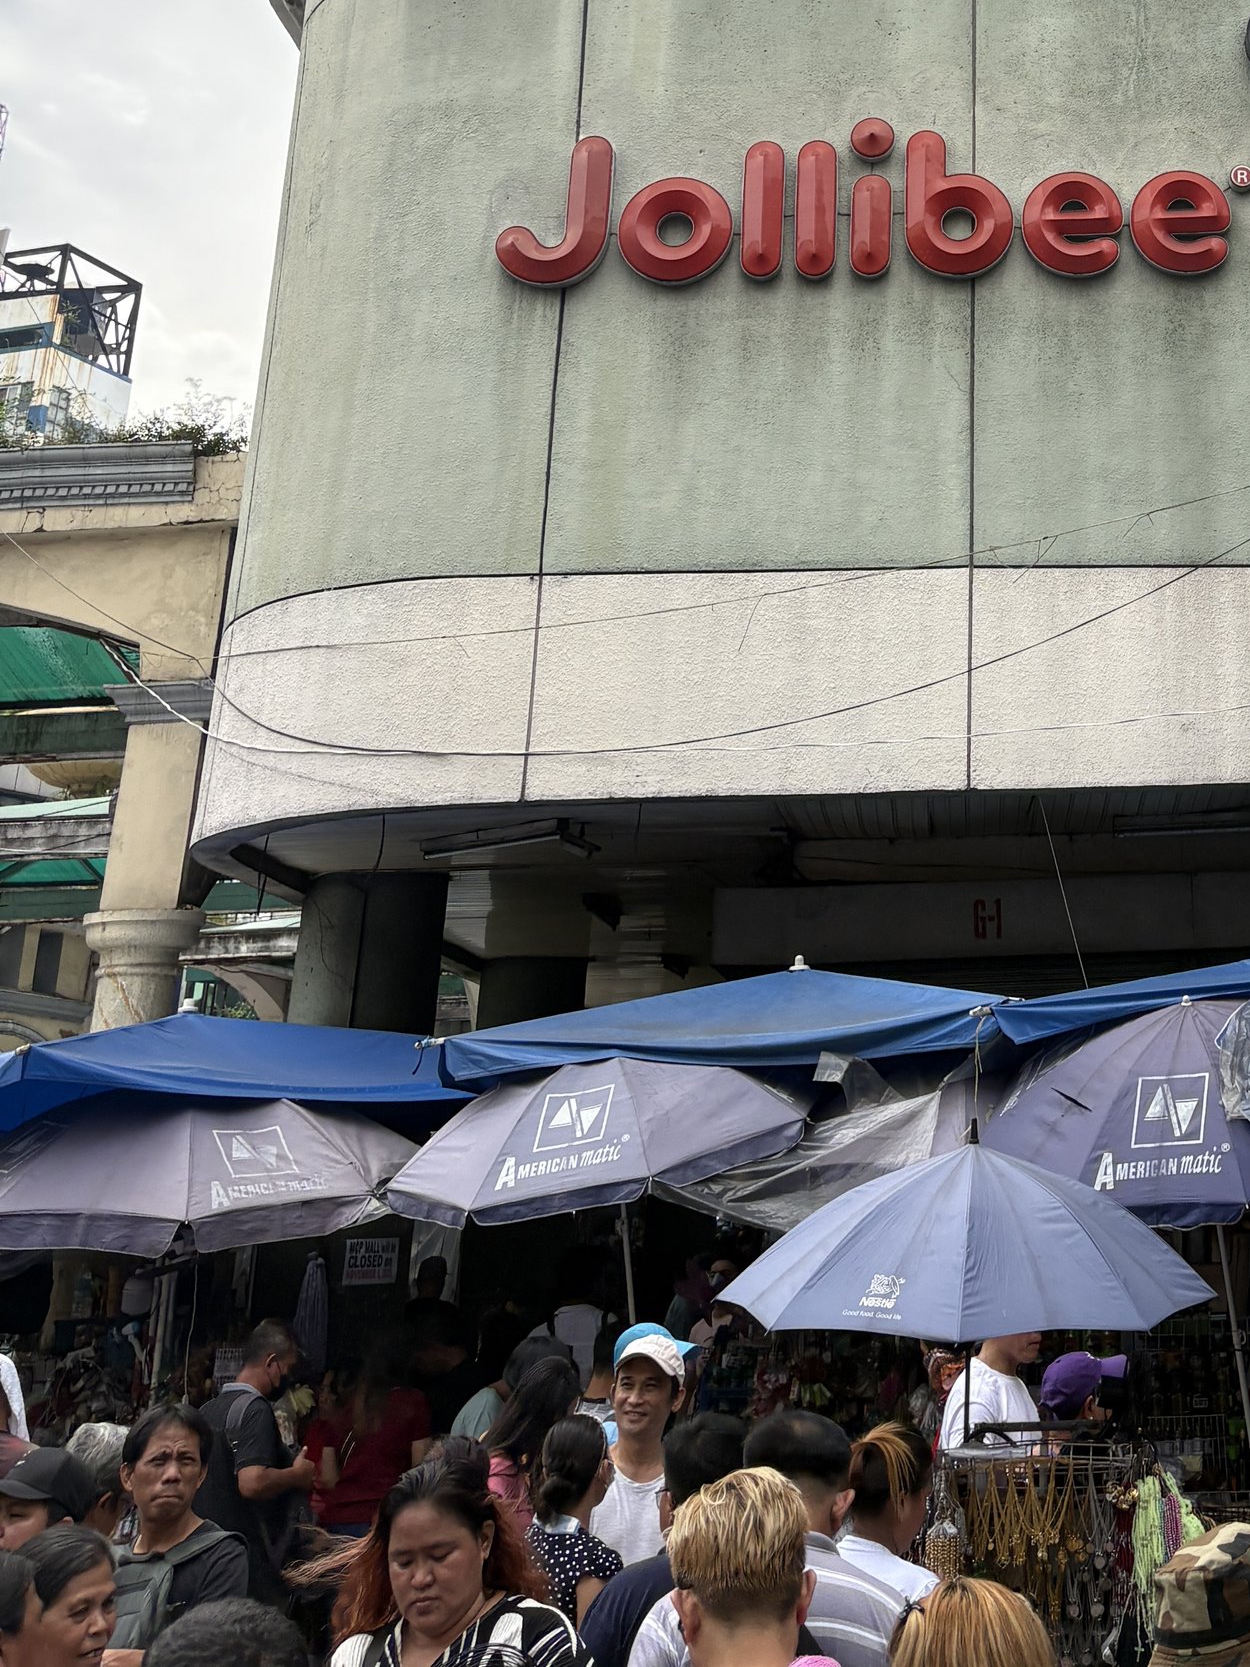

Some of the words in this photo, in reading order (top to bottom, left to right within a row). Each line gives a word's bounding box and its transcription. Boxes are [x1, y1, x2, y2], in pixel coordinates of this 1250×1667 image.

[974, 898, 1002, 940] G-1
[494, 1154, 579, 1191] AMERICAN
[1093, 1152, 1178, 1191] AMERICAN
[348, 1254, 383, 1268] CLOSED
[842, 1308, 859, 1317] Good
[875, 1312, 893, 1320] Good
